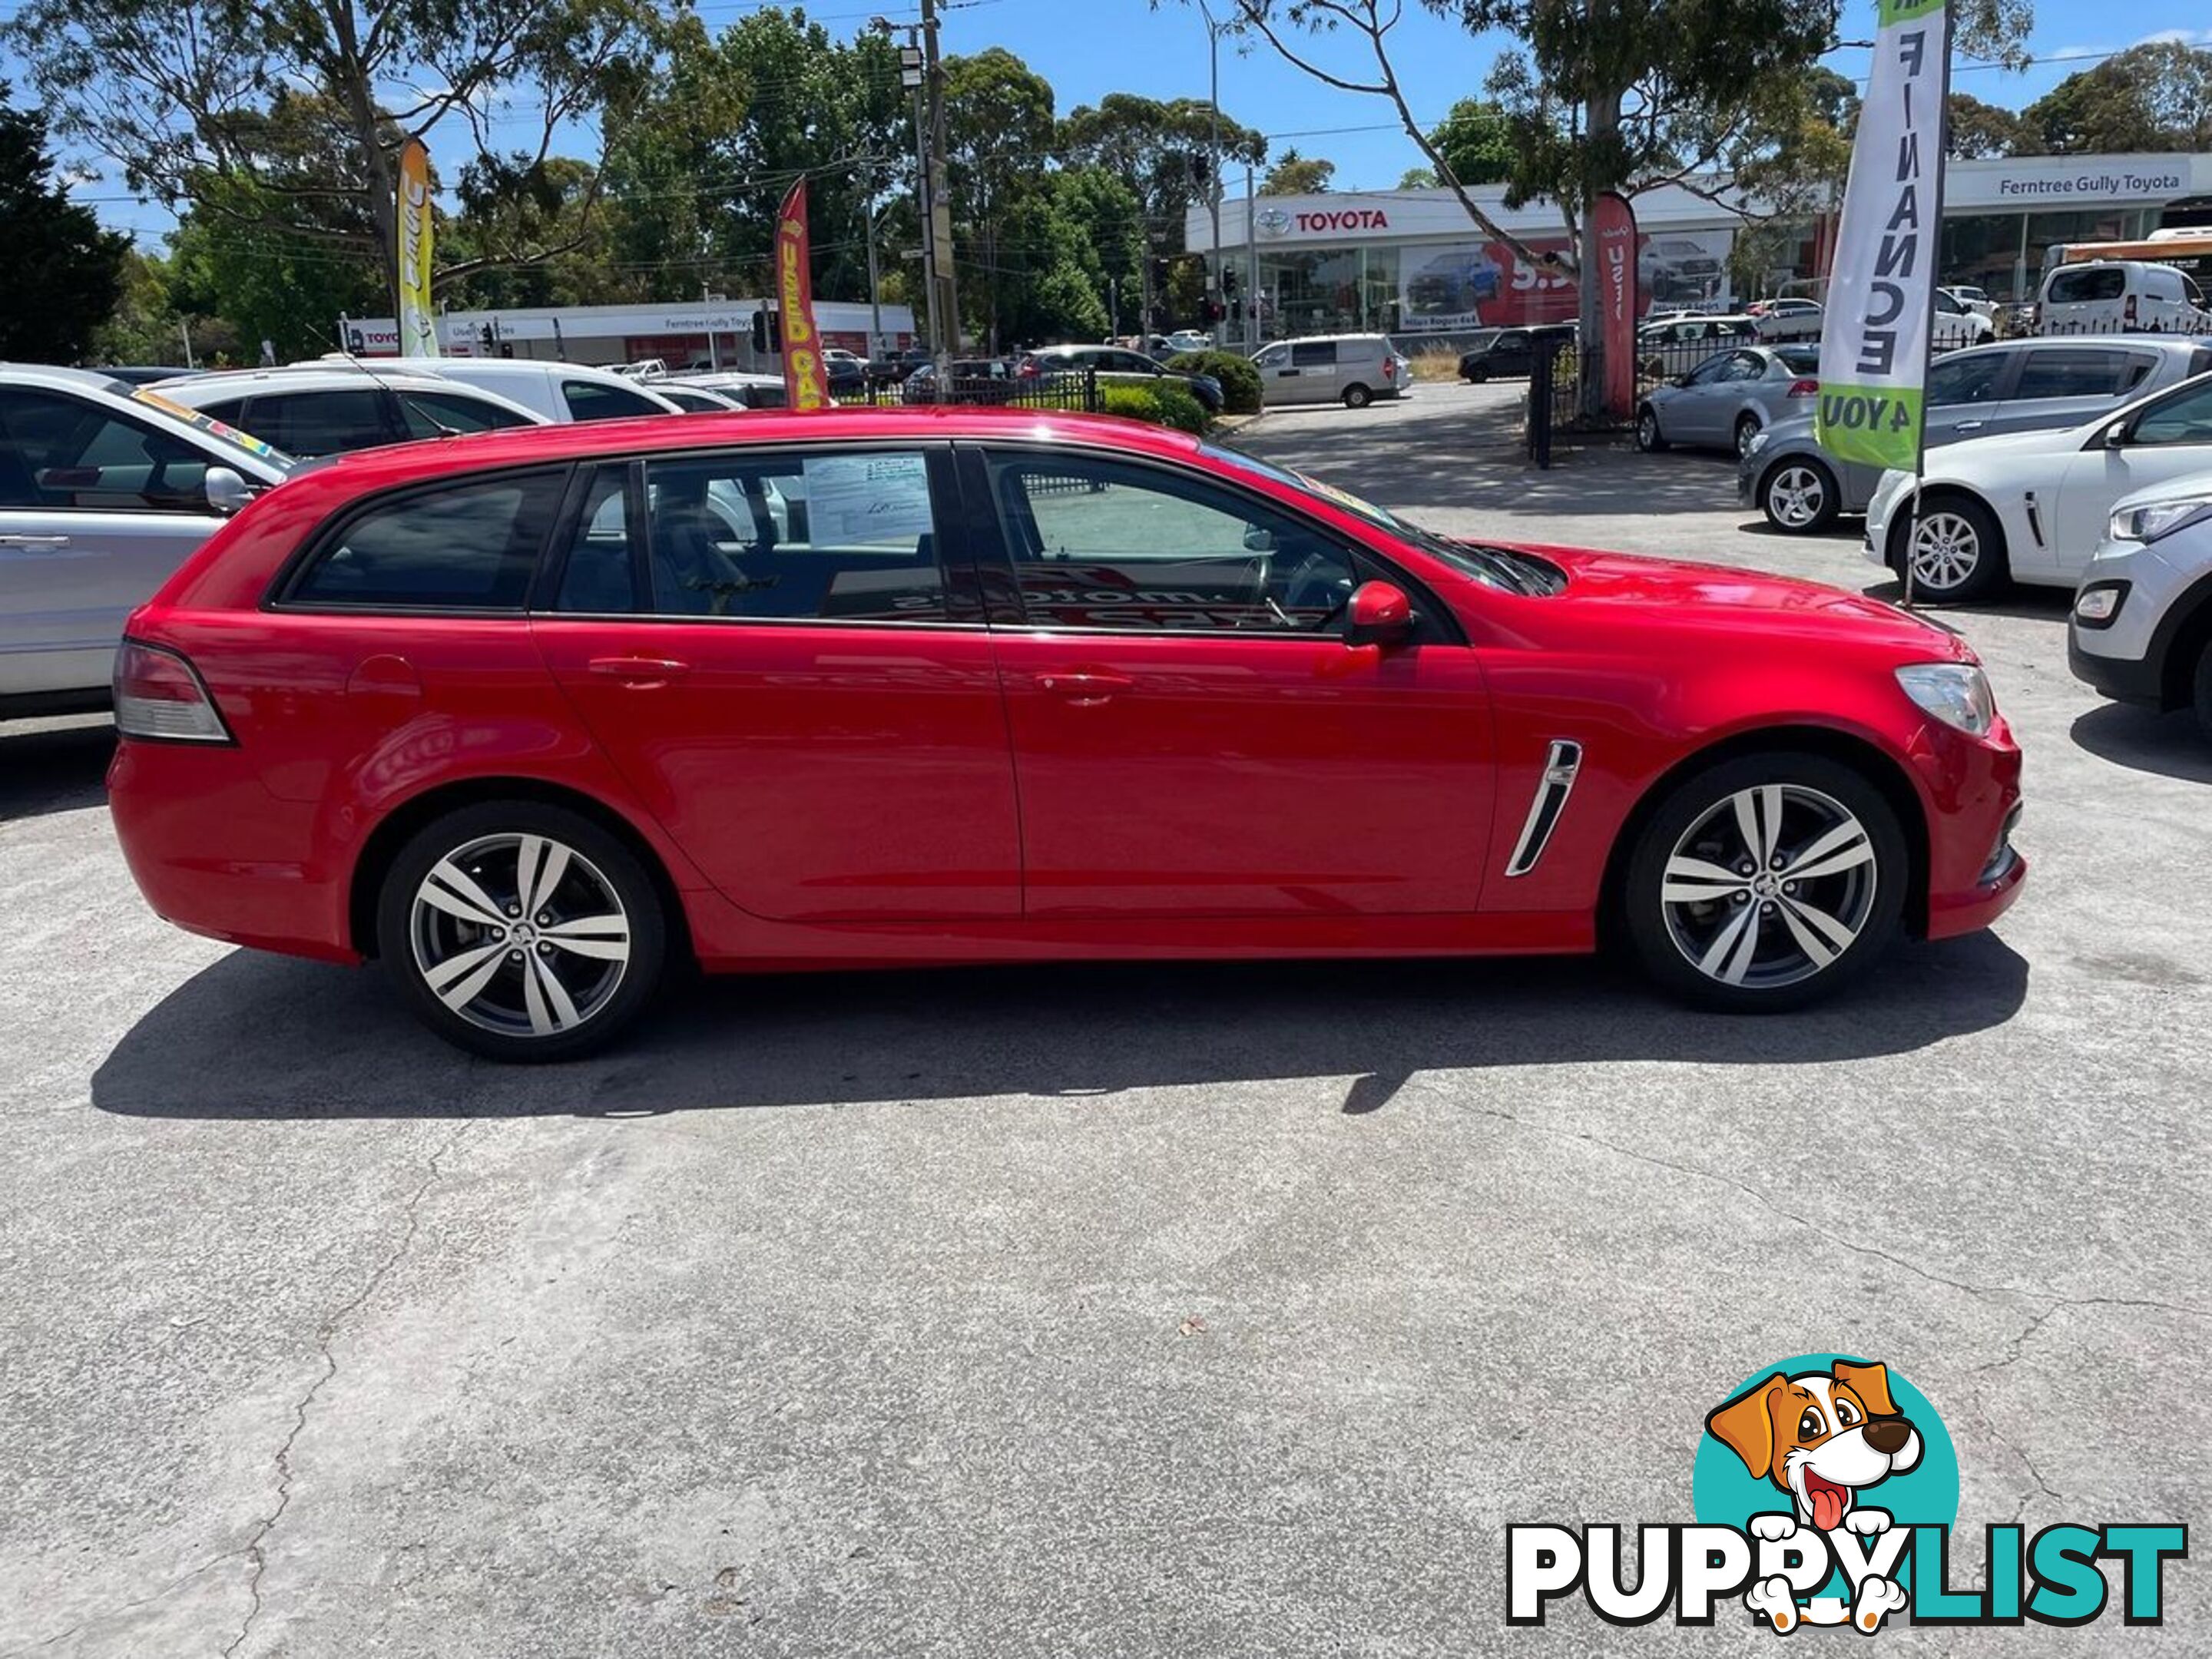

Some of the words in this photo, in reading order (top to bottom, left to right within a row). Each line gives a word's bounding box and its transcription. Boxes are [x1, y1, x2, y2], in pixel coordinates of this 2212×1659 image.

[2000, 179, 2072, 194] Ferntree
[2076, 176, 2120, 194] Gully
[2124, 174, 2180, 193] Toyota
[1296, 210, 1388, 232] TOYOTA
[782, 240, 811, 343] USED
